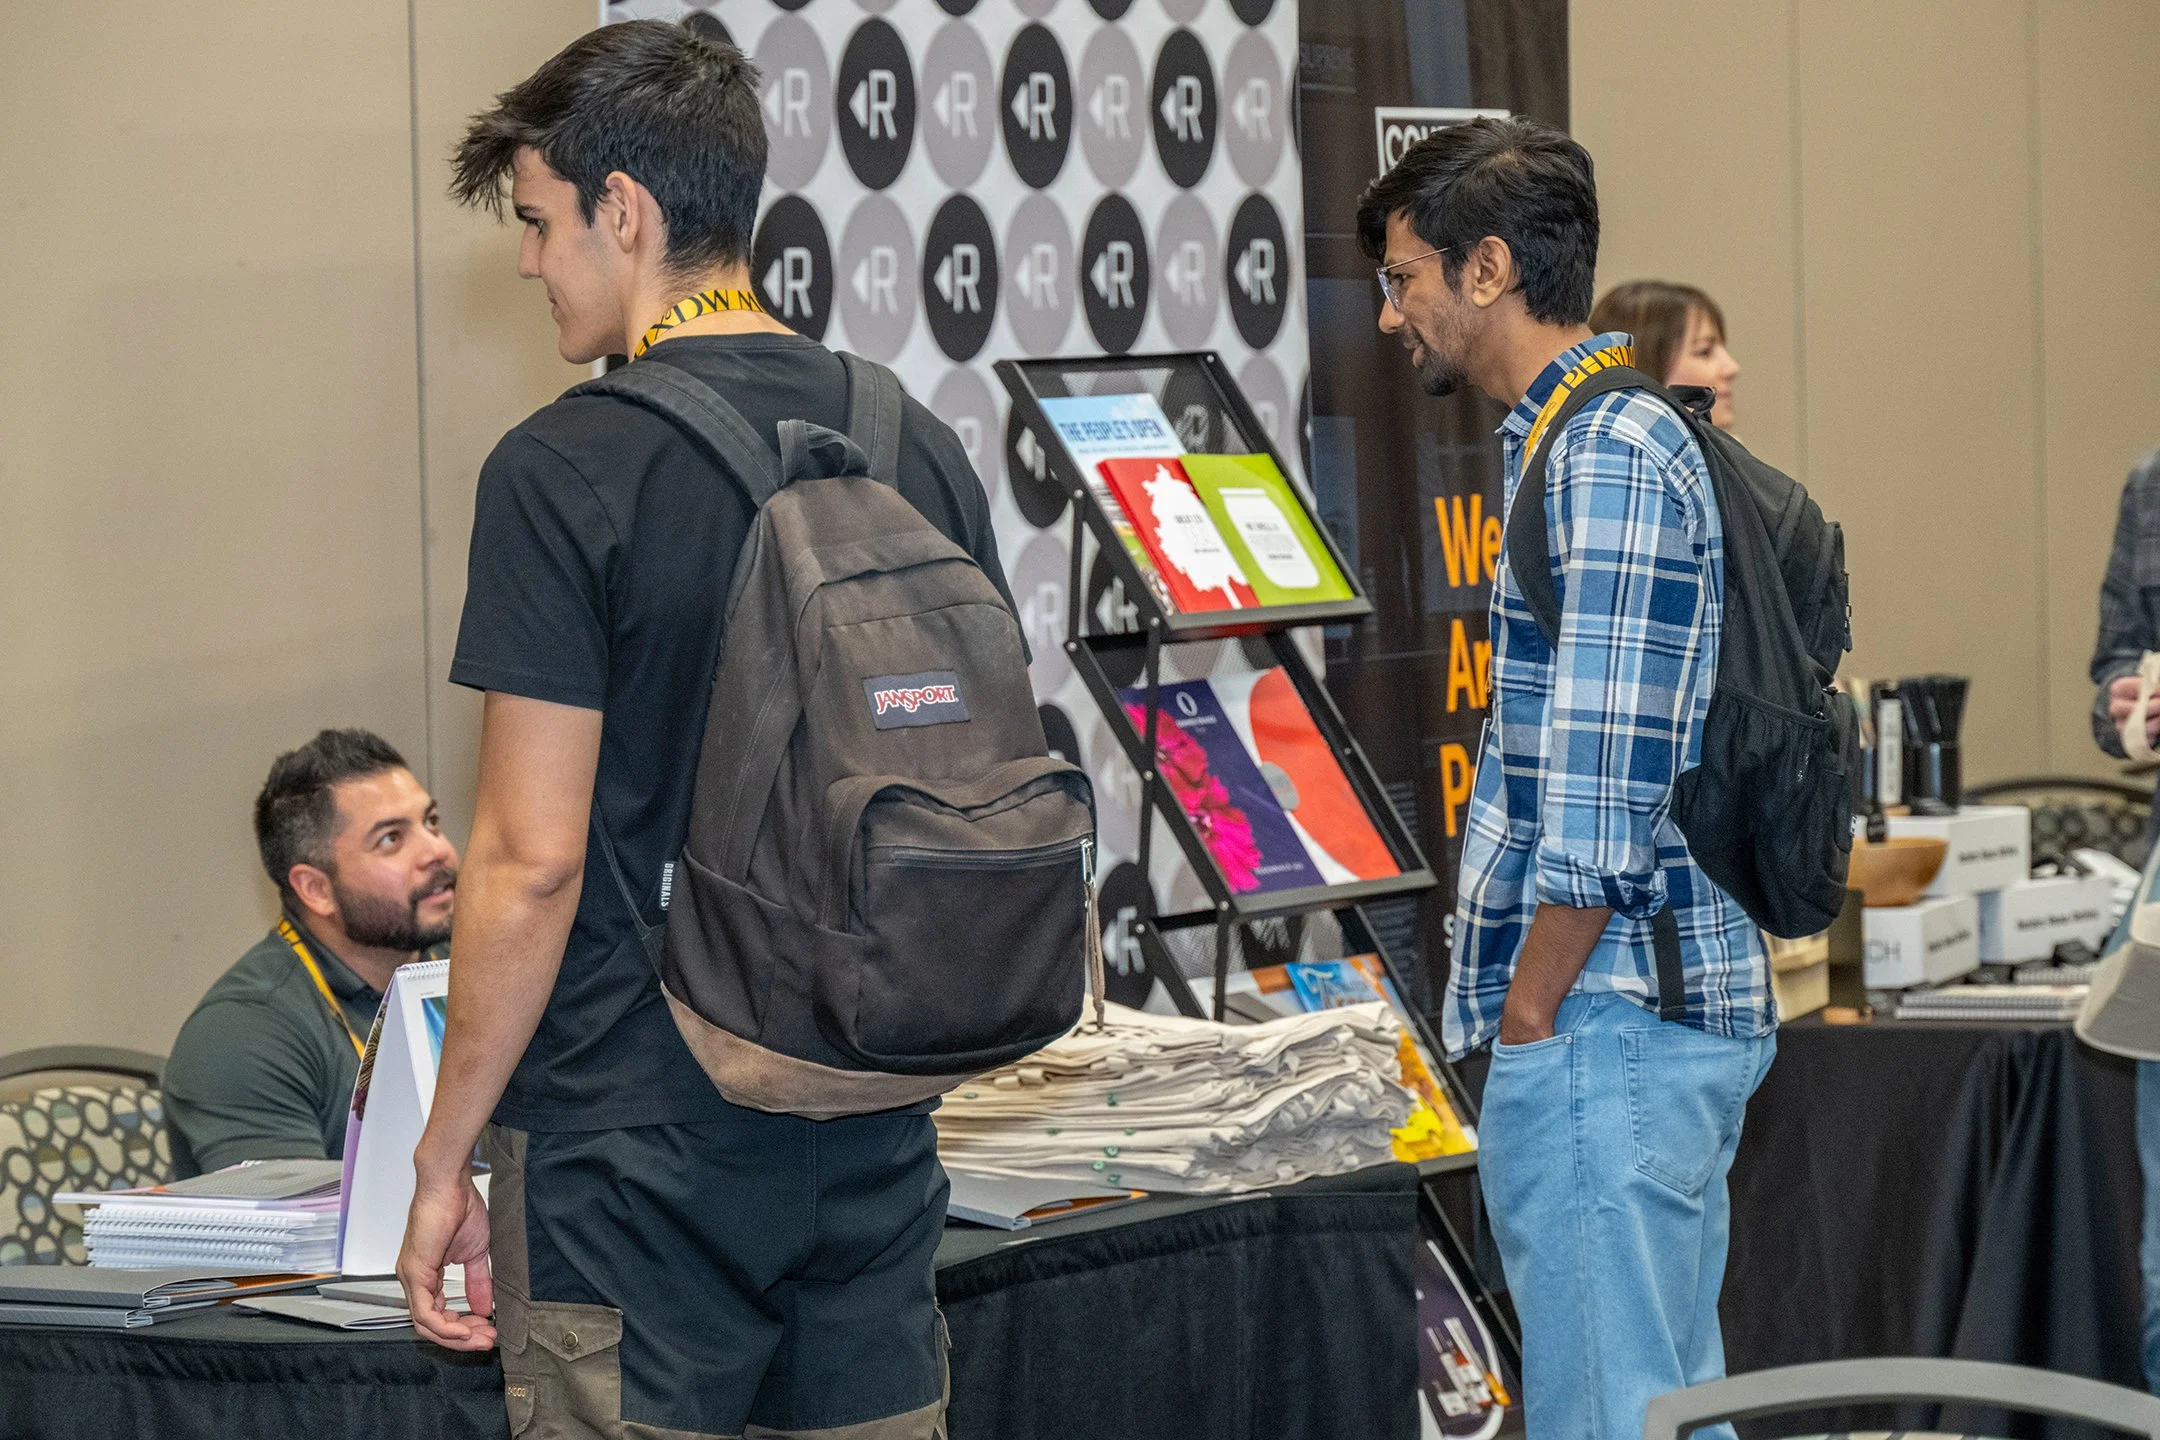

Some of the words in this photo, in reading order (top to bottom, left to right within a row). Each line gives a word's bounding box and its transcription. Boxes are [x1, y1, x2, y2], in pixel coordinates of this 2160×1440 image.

[1058, 422, 1086, 441] THE
[1081, 420, 1136, 440] PEOPLE'S
[1131, 418, 1165, 438] OPEN
[1434, 493, 1503, 588] We
[874, 685, 955, 715] JANSPORT
[661, 863, 674, 907] ORIGINALS
